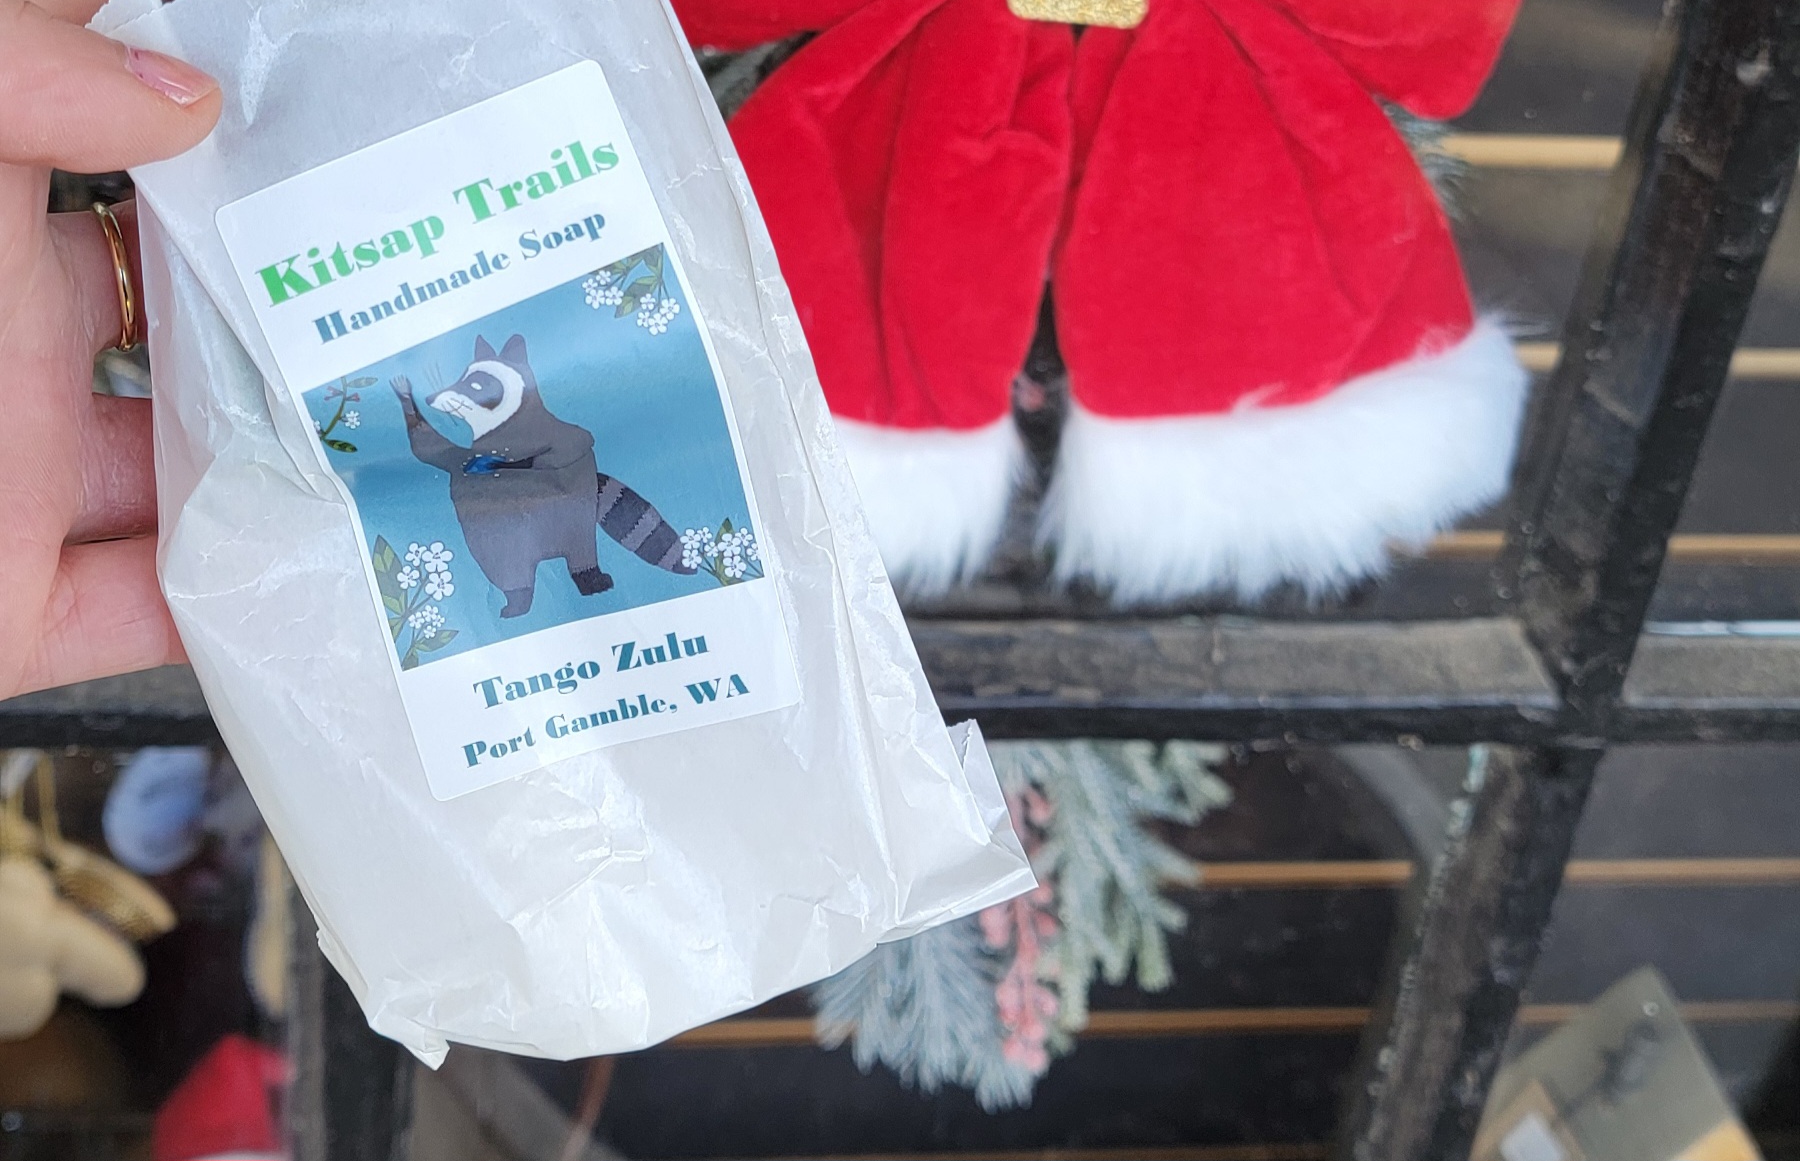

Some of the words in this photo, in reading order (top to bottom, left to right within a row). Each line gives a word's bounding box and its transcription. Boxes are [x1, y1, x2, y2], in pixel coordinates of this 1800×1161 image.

[254, 214, 446, 308] Kitsap
[452, 140, 621, 225] Trails
[311, 250, 512, 345] Handmade
[518, 212, 606, 262] Soap
[460, 726, 537, 769] Port
[545, 693, 678, 740] Gamble,
[685, 673, 751, 705] WA
[472, 659, 602, 711] Tango
[610, 631, 710, 673] Zulu
